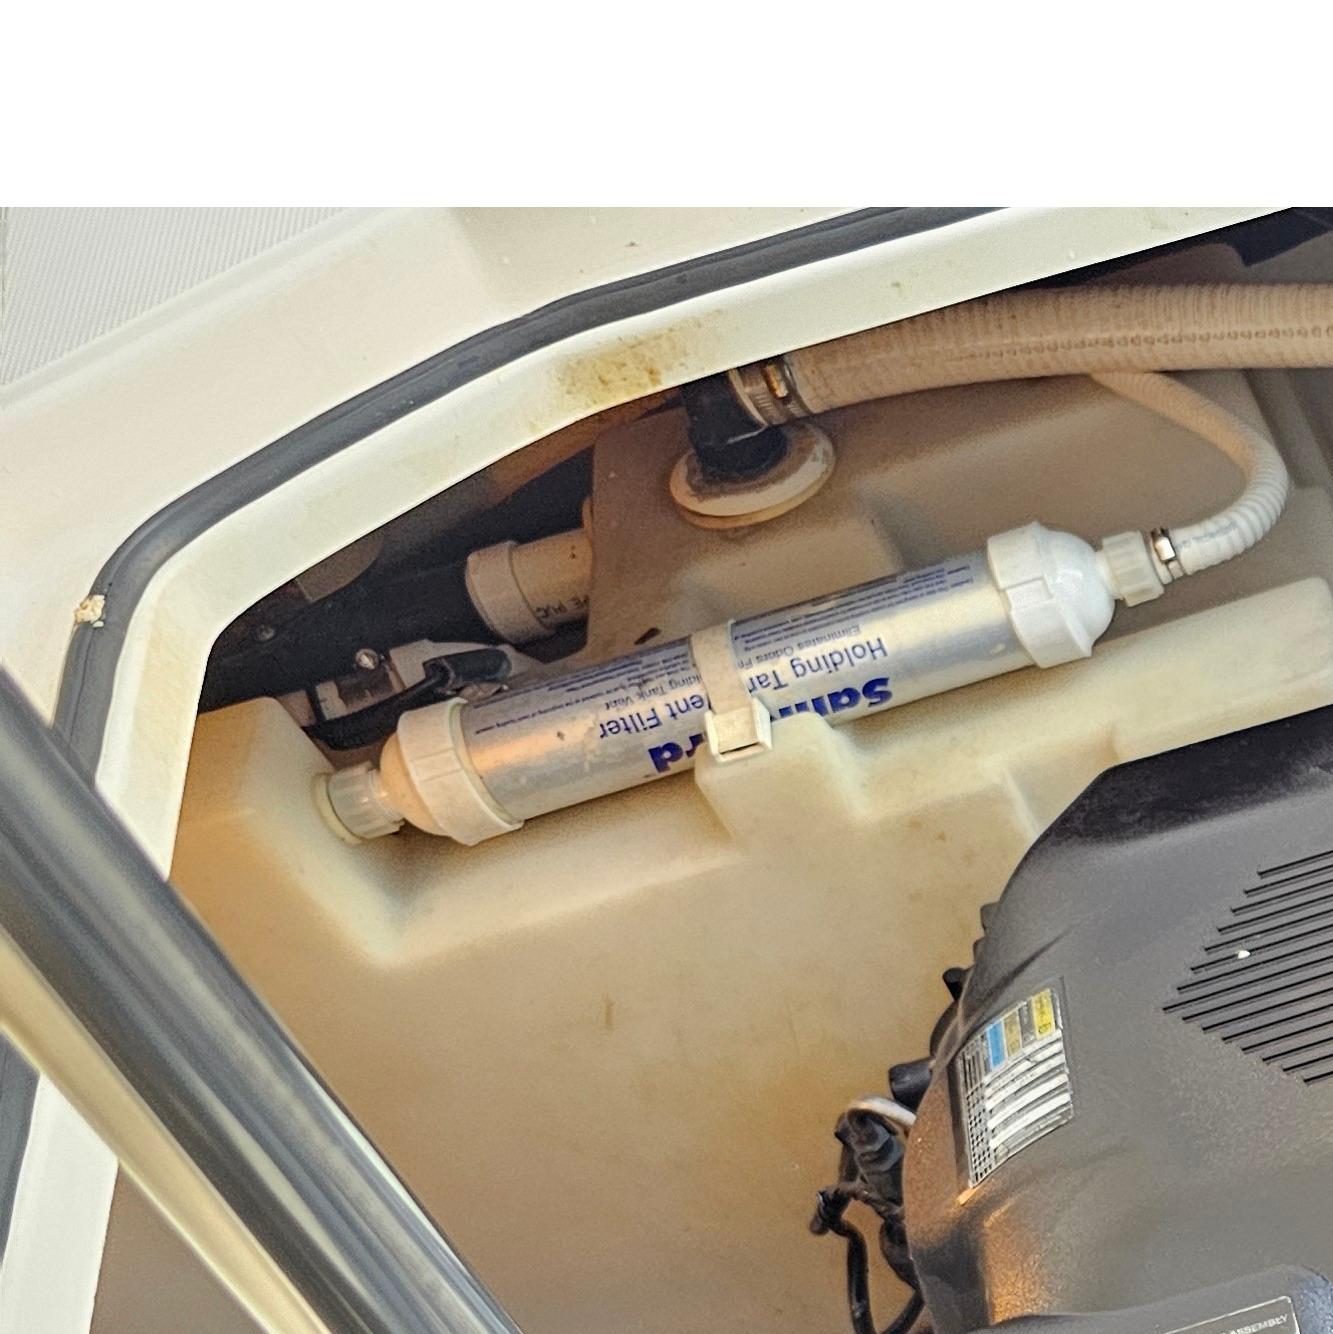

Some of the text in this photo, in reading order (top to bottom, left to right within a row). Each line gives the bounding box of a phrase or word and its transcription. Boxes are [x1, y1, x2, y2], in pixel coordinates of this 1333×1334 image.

[791, 637, 889, 680] Holding
[640, 683, 668, 698] Tank
[668, 692, 712, 718] ent
[600, 707, 665, 740] Filter
